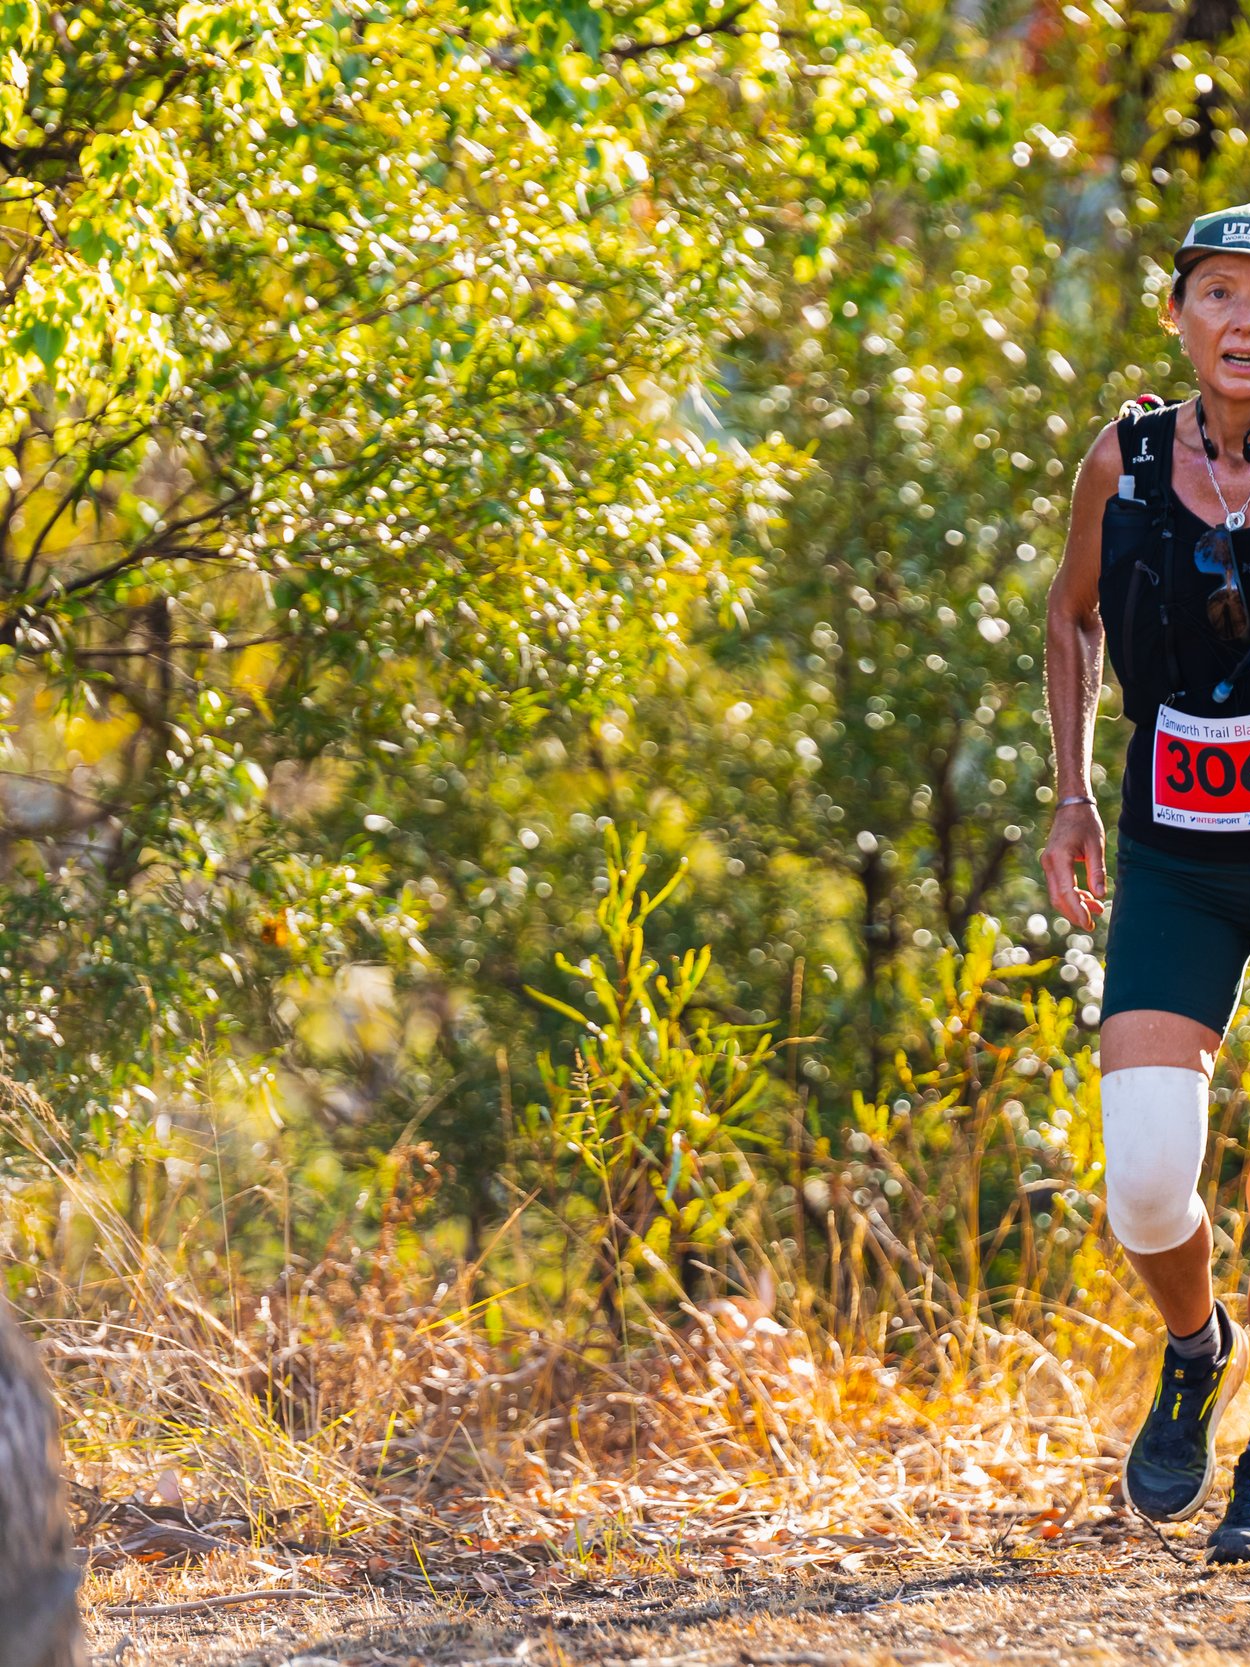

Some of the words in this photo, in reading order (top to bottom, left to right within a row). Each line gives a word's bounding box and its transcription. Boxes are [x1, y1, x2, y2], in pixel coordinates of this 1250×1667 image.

[1161, 714, 1200, 737] Tamworth
[1203, 726, 1230, 738] Trail
[1159, 807, 1186, 823] 45km
[1196, 816, 1241, 825] INTERSPORT
